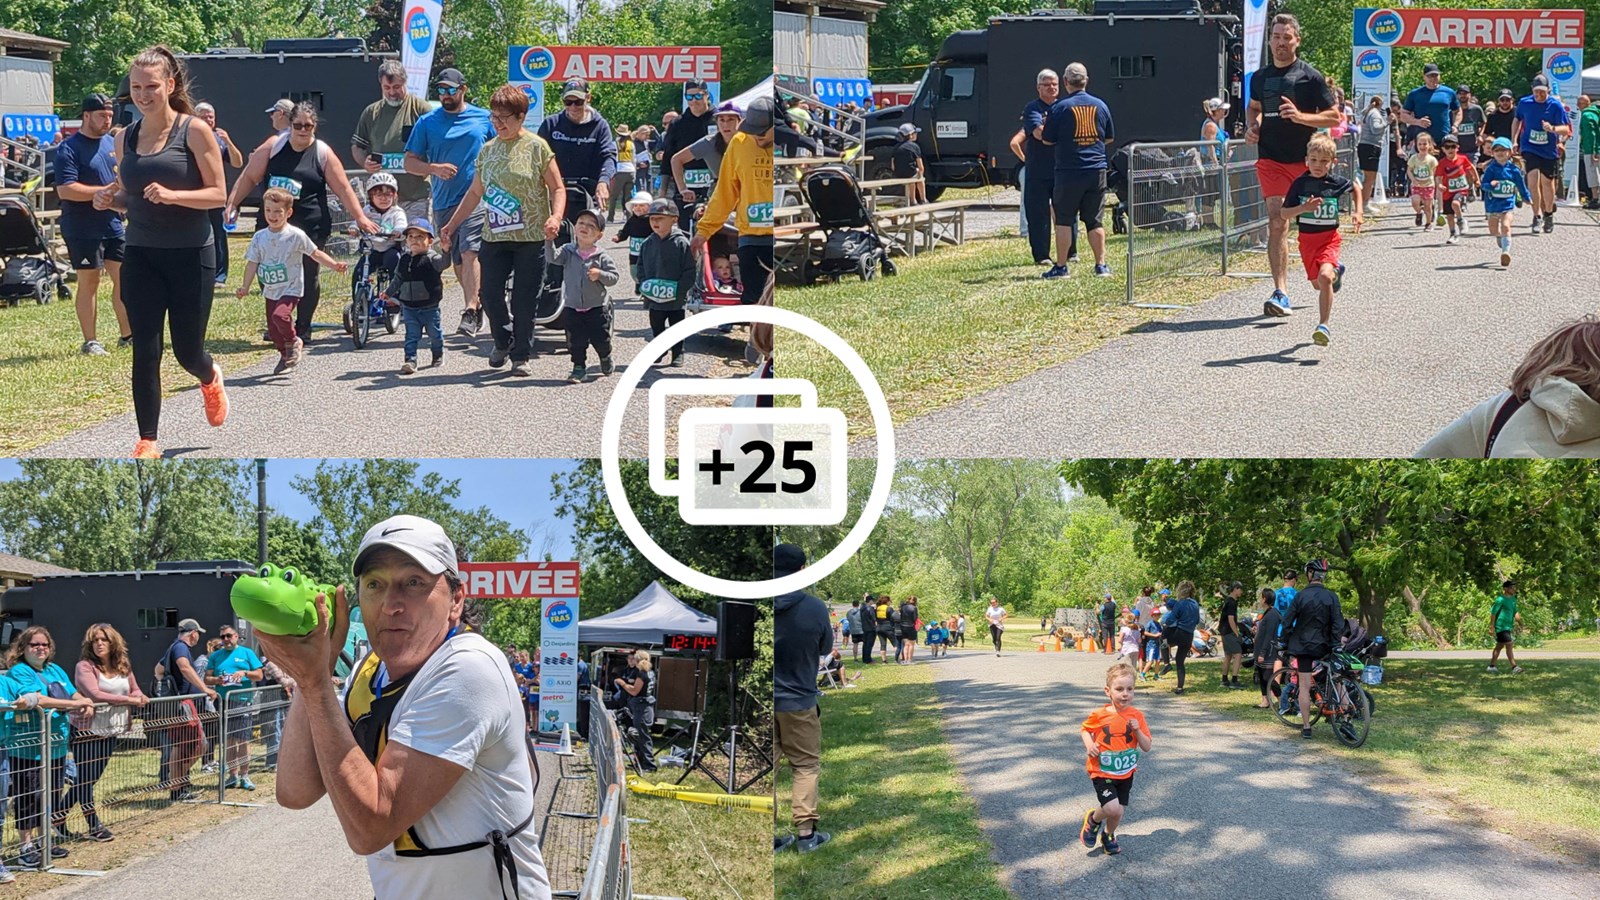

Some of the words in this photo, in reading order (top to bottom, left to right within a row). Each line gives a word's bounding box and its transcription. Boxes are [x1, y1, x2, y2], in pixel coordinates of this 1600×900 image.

[410, 26, 430, 40] FRAS
[1375, 24, 1397, 35] FRAS
[1412, 11, 1580, 45] ARRIVÉE
[528, 60, 549, 71] FRAS
[563, 48, 718, 79] ARRIVÉE
[1361, 63, 1382, 72] FRAS
[1552, 65, 1574, 74] FRAS
[694, 173, 711, 184] 120
[492, 194, 516, 214] 012
[1313, 204, 1336, 218] 019
[264, 268, 286, 284] 035
[651, 284, 675, 299] 028
[550, 613, 571, 623] FRAS
[1113, 753, 1137, 770] 023
